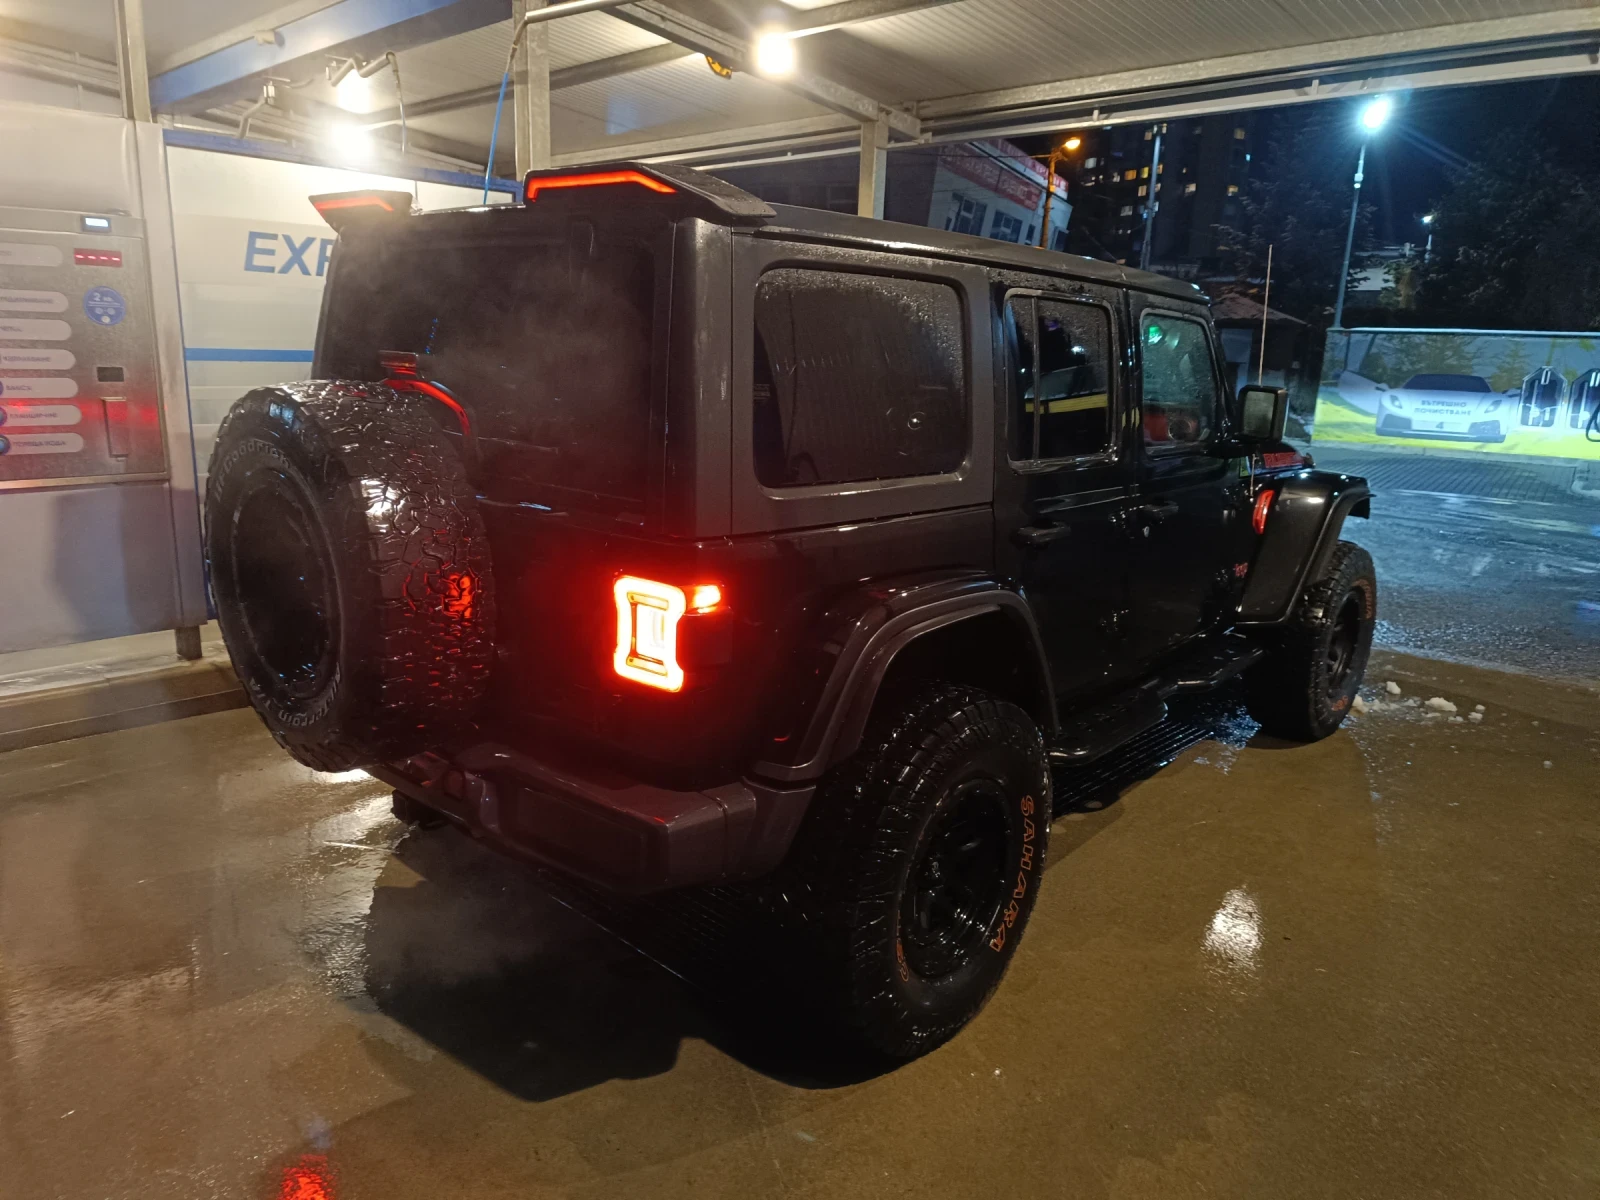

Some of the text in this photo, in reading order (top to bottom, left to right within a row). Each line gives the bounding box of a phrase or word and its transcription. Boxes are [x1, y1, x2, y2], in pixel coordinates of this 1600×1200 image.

[1421, 400, 1467, 408] ВЪТРЕШНО
[1414, 408, 1471, 416] ПОЧИСТВАНЕ
[1435, 421, 1444, 429] 4
[990, 794, 1035, 952] SAHARA
